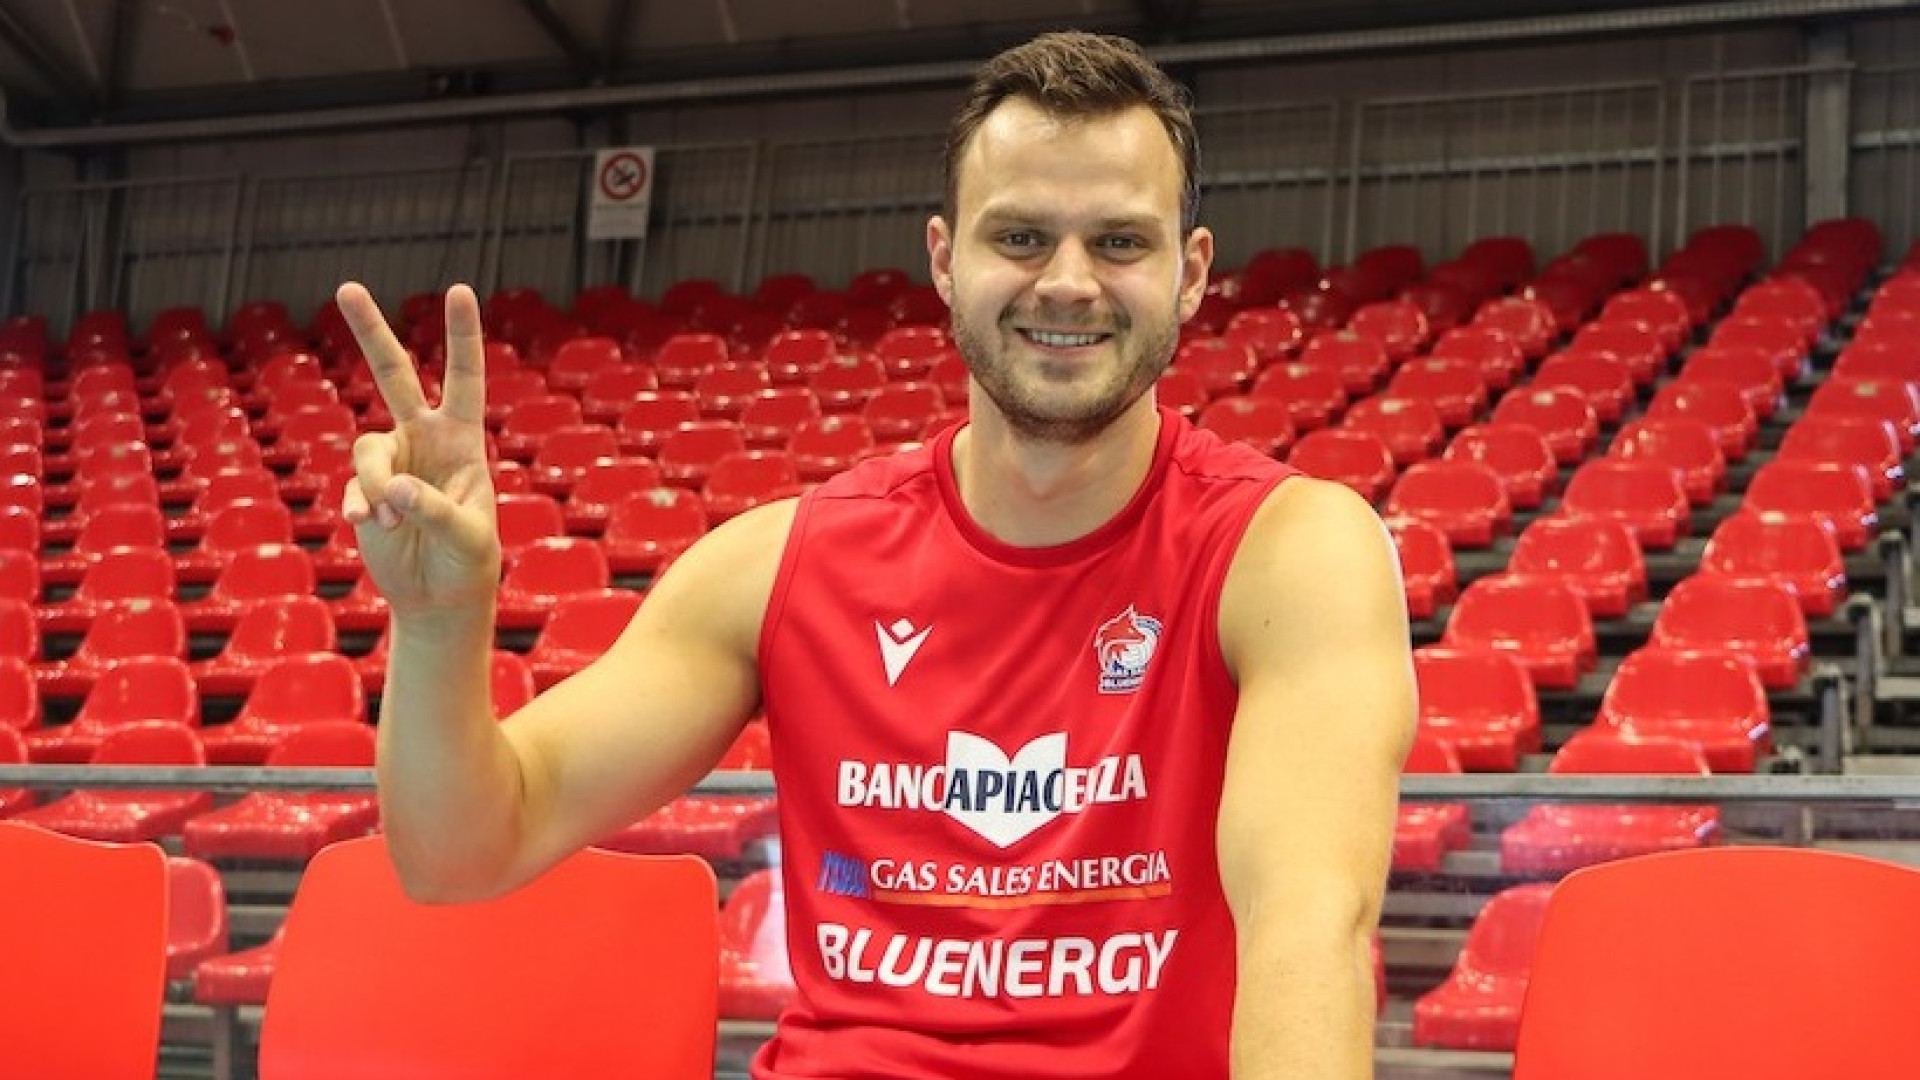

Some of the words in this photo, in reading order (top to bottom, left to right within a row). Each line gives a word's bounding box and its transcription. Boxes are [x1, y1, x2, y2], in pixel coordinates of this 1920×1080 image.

[870, 859, 938, 891] GAS
[945, 863, 1034, 897] SALES
[1035, 851, 1171, 891] ENERGIA
[816, 923, 1180, 998] BLUENERGY
